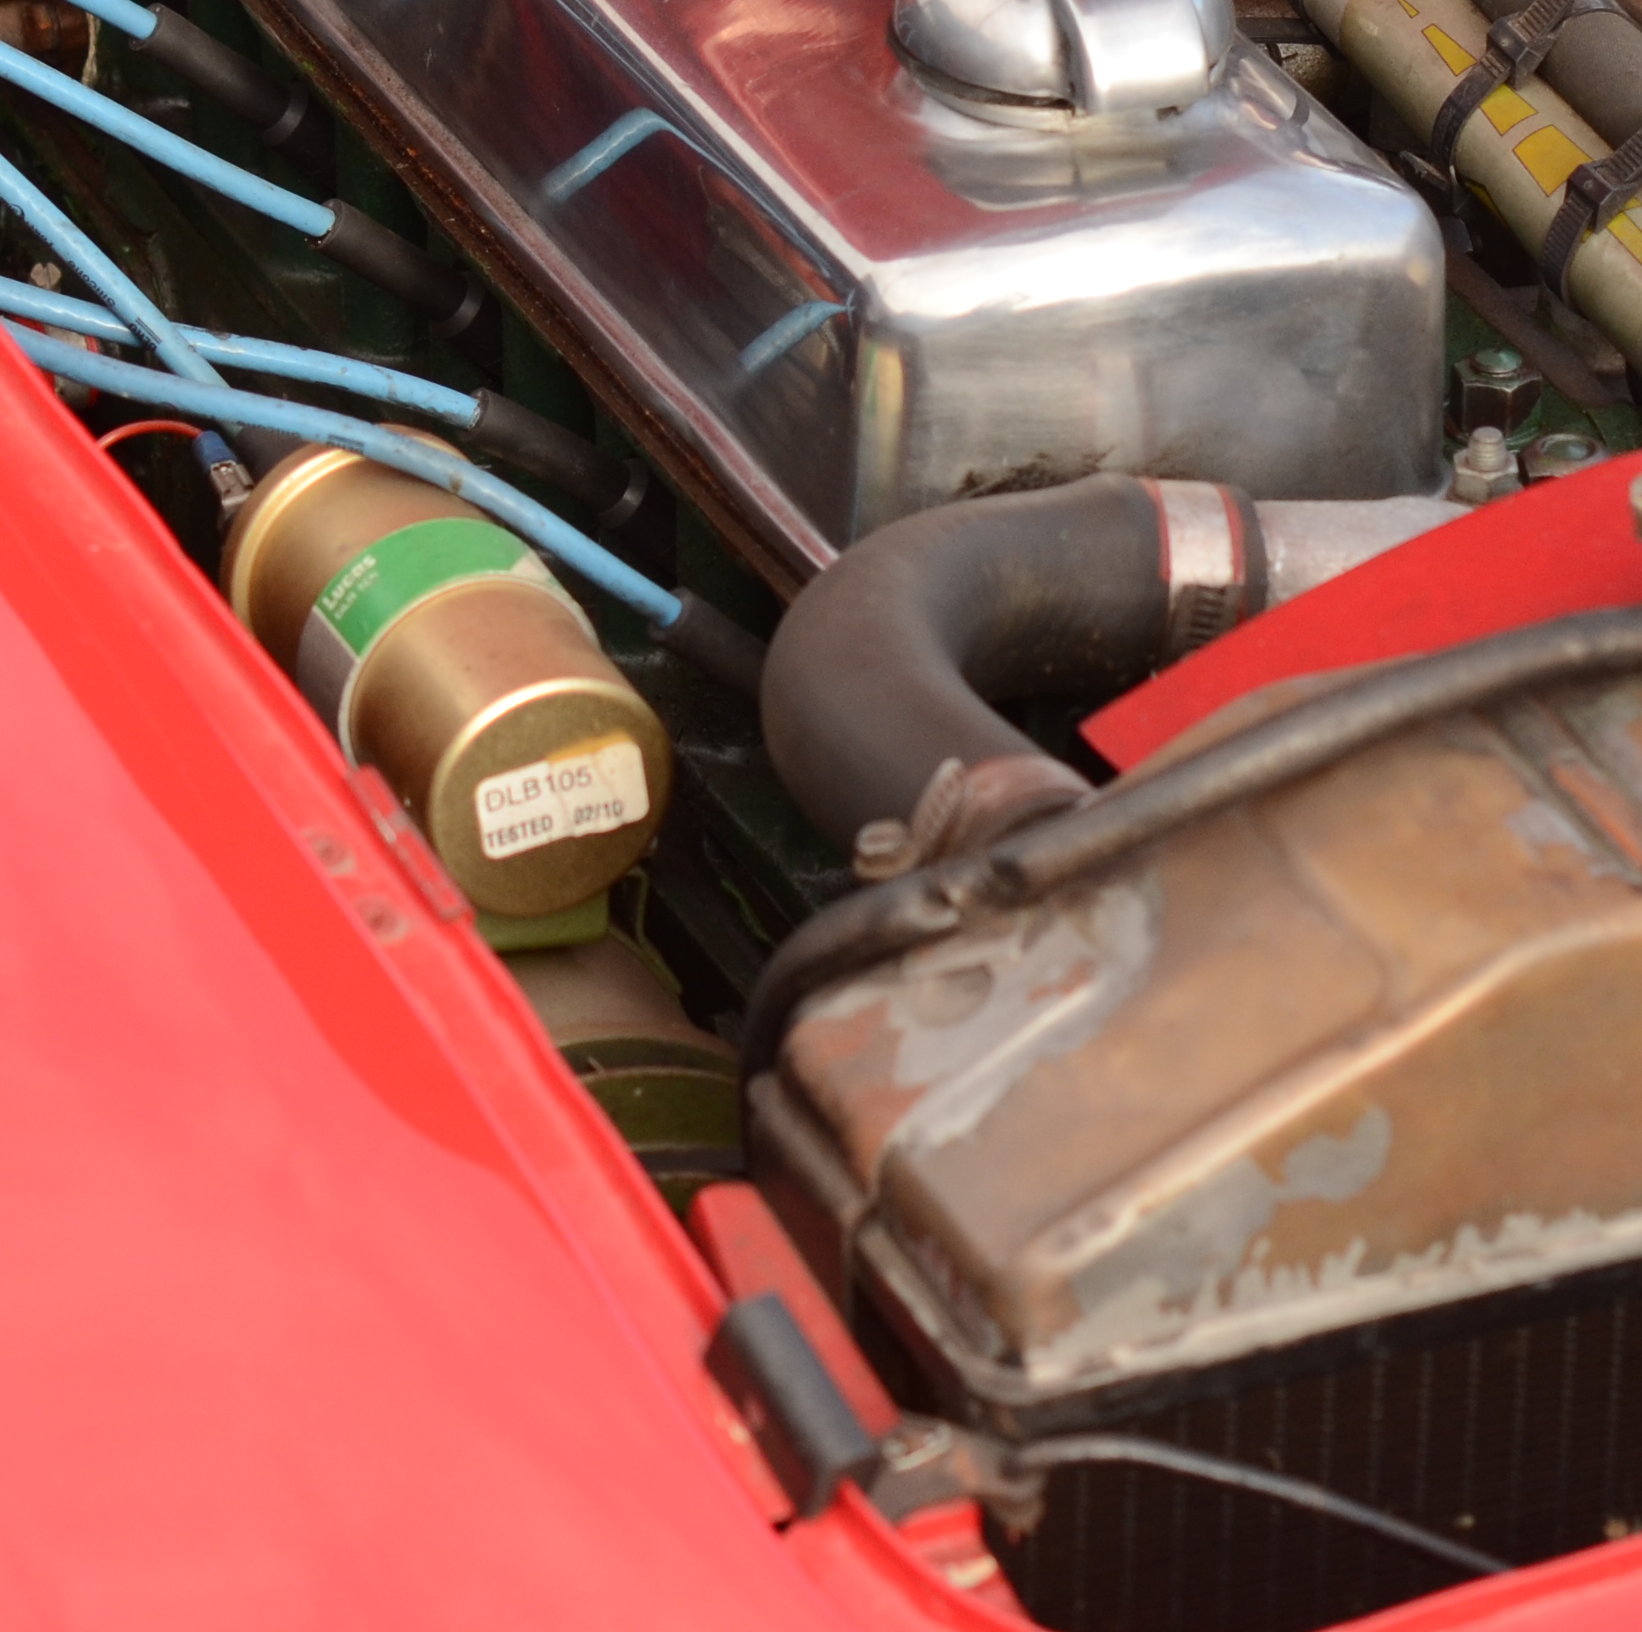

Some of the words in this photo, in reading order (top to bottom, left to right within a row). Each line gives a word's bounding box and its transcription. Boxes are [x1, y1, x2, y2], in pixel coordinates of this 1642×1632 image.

[322, 554, 377, 611] Lucas
[485, 766, 592, 813] DLB105
[486, 814, 553, 848] TESTED
